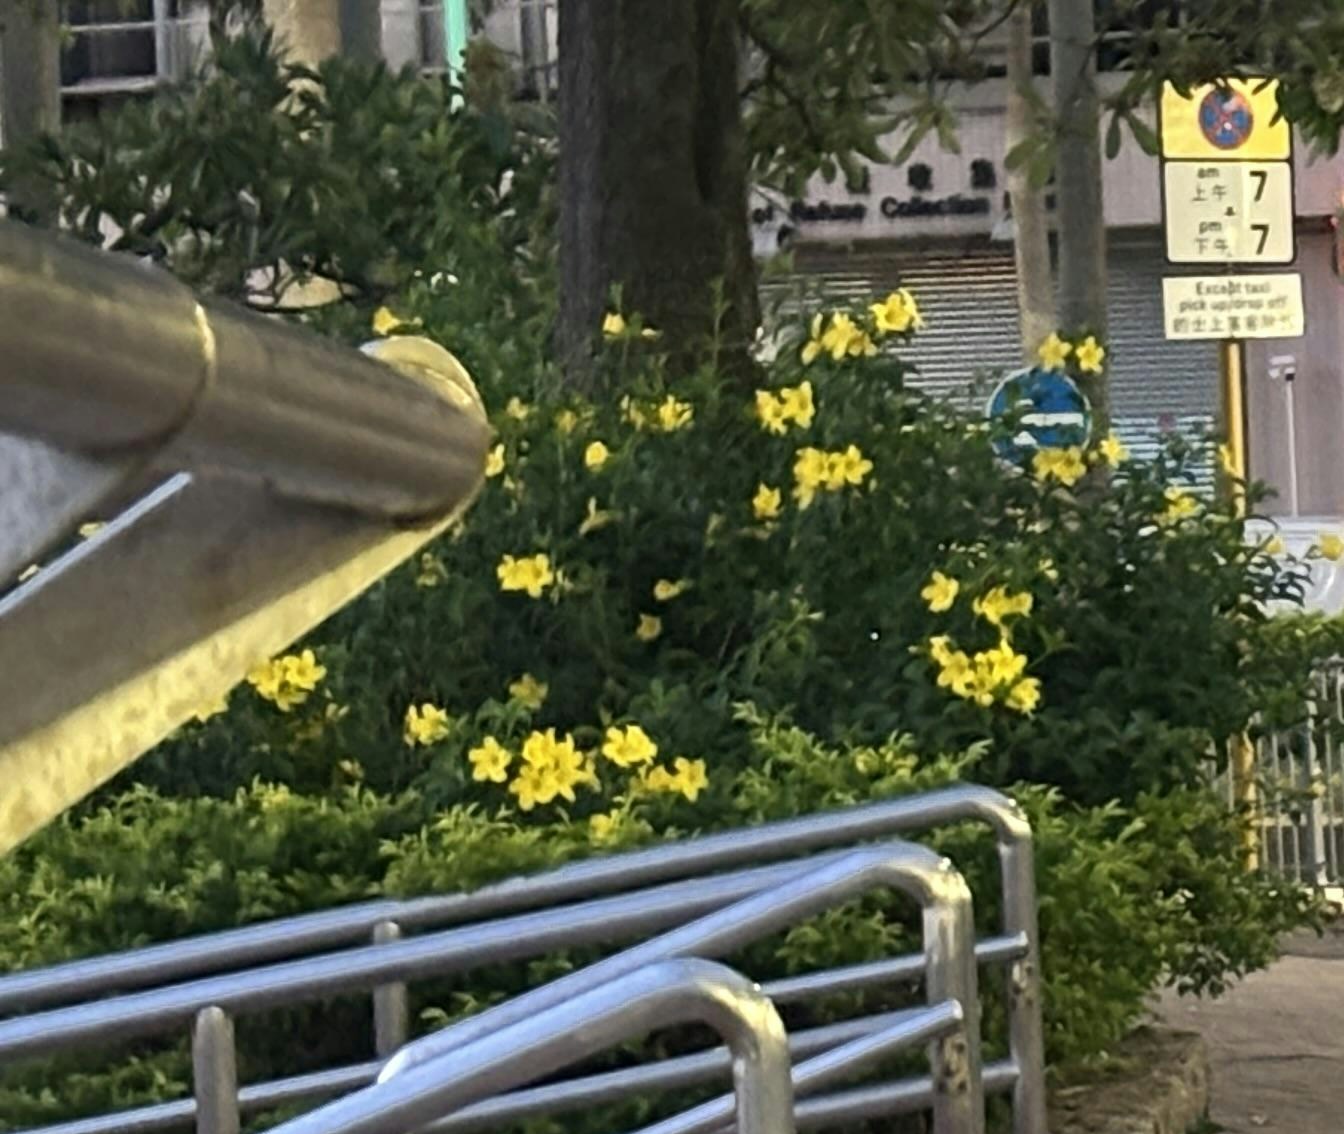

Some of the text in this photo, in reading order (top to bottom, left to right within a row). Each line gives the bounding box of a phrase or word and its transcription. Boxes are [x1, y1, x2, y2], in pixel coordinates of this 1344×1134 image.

[1191, 184, 1227, 202] 上午
[1197, 168, 1268, 202] am 7
[1194, 237, 1229, 255] 下午
[1199, 221, 1270, 255] pm 7
[1195, 280, 1242, 296] Except
[1179, 299, 1207, 313] pick
